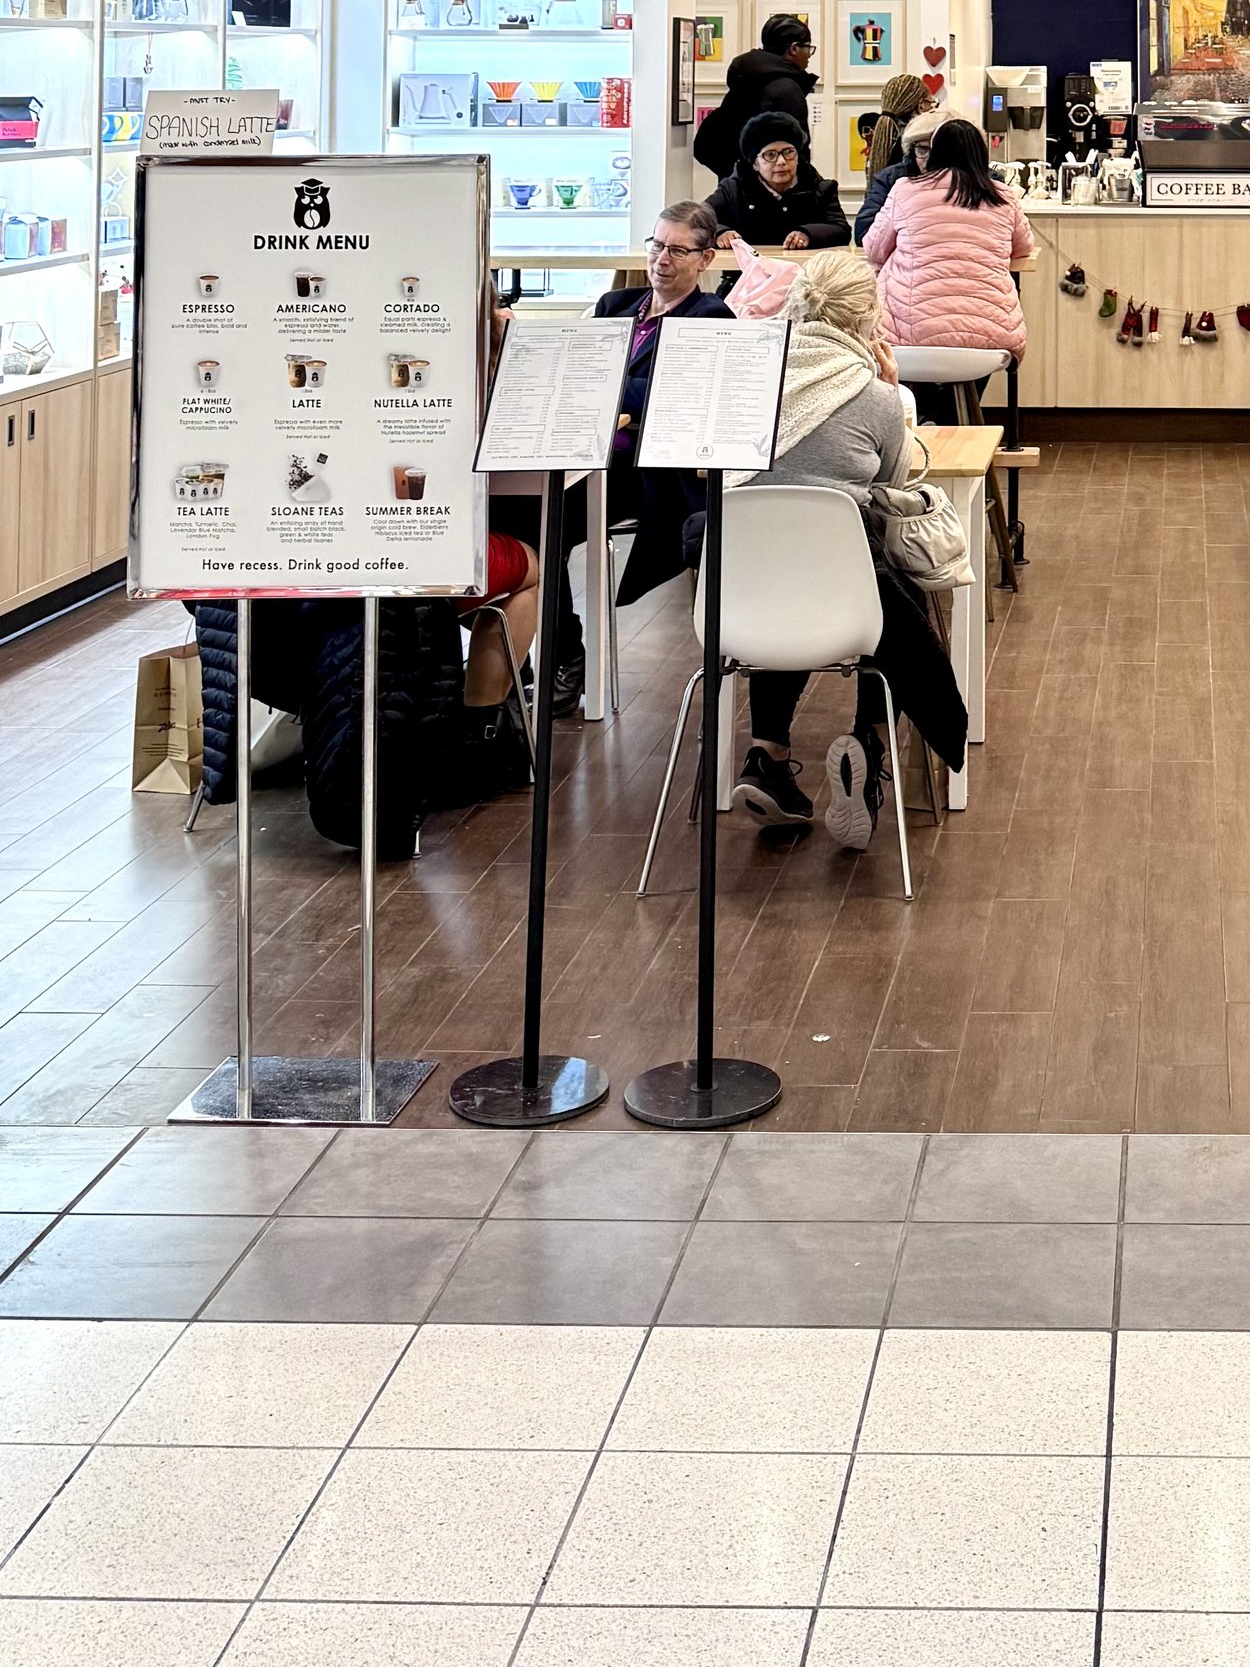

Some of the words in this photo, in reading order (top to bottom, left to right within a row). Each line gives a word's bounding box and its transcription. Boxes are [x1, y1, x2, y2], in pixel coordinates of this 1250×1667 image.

[146, 115, 220, 140] SPANISH
[228, 116, 276, 134] LATTE
[1157, 183, 1225, 195] COFFEE
[254, 235, 310, 250] DRINK
[316, 235, 370, 250] MENU
[182, 304, 235, 313] ESPRESSO
[276, 304, 346, 313] AMERICANO
[384, 304, 440, 313] CORTADO
[292, 399, 321, 408] LATTE
[374, 399, 419, 408] NUTELLA
[424, 399, 452, 408] LATTE
[177, 507, 196, 516] TEA
[200, 507, 230, 516] LATTE
[271, 507, 314, 516] SLOANE
[319, 507, 344, 516] TEAS
[366, 507, 412, 515] SUMMER
[416, 507, 450, 515] BREAK
[202, 559, 234, 570] Have
[288, 558, 321, 570] Drink
[327, 558, 359, 573] good
[365, 558, 408, 570] coffee.
